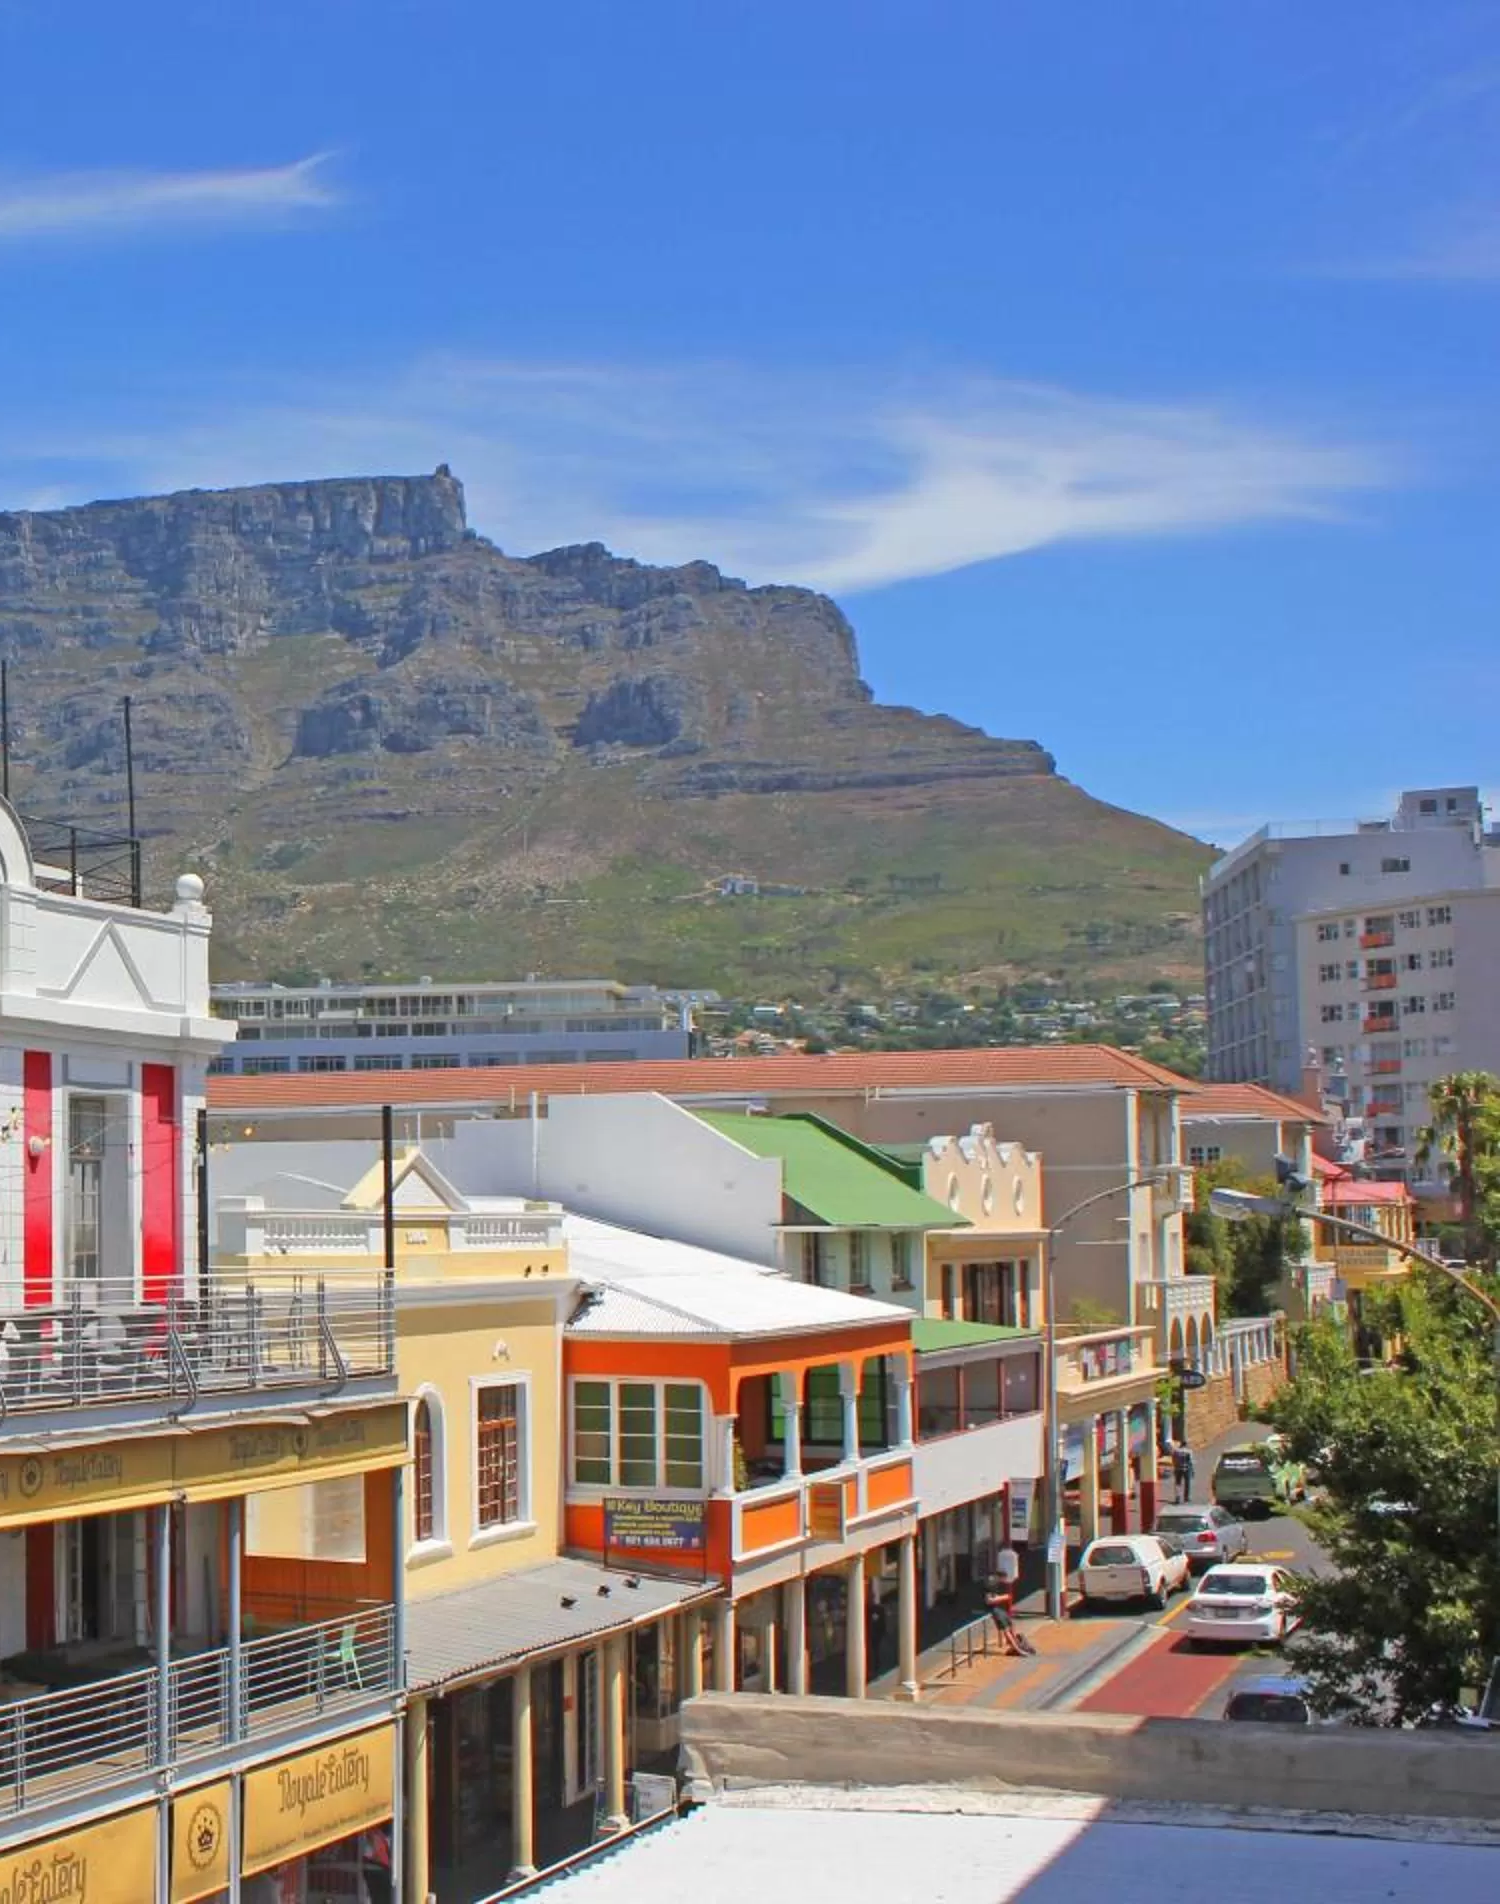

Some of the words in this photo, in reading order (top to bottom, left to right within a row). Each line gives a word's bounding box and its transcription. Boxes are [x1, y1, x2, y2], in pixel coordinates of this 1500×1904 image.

[617, 1499, 641, 1514] Key
[277, 1759, 327, 1818] Royale
[324, 1748, 370, 1794] Eatery
[23, 1851, 87, 1904] Eatery
